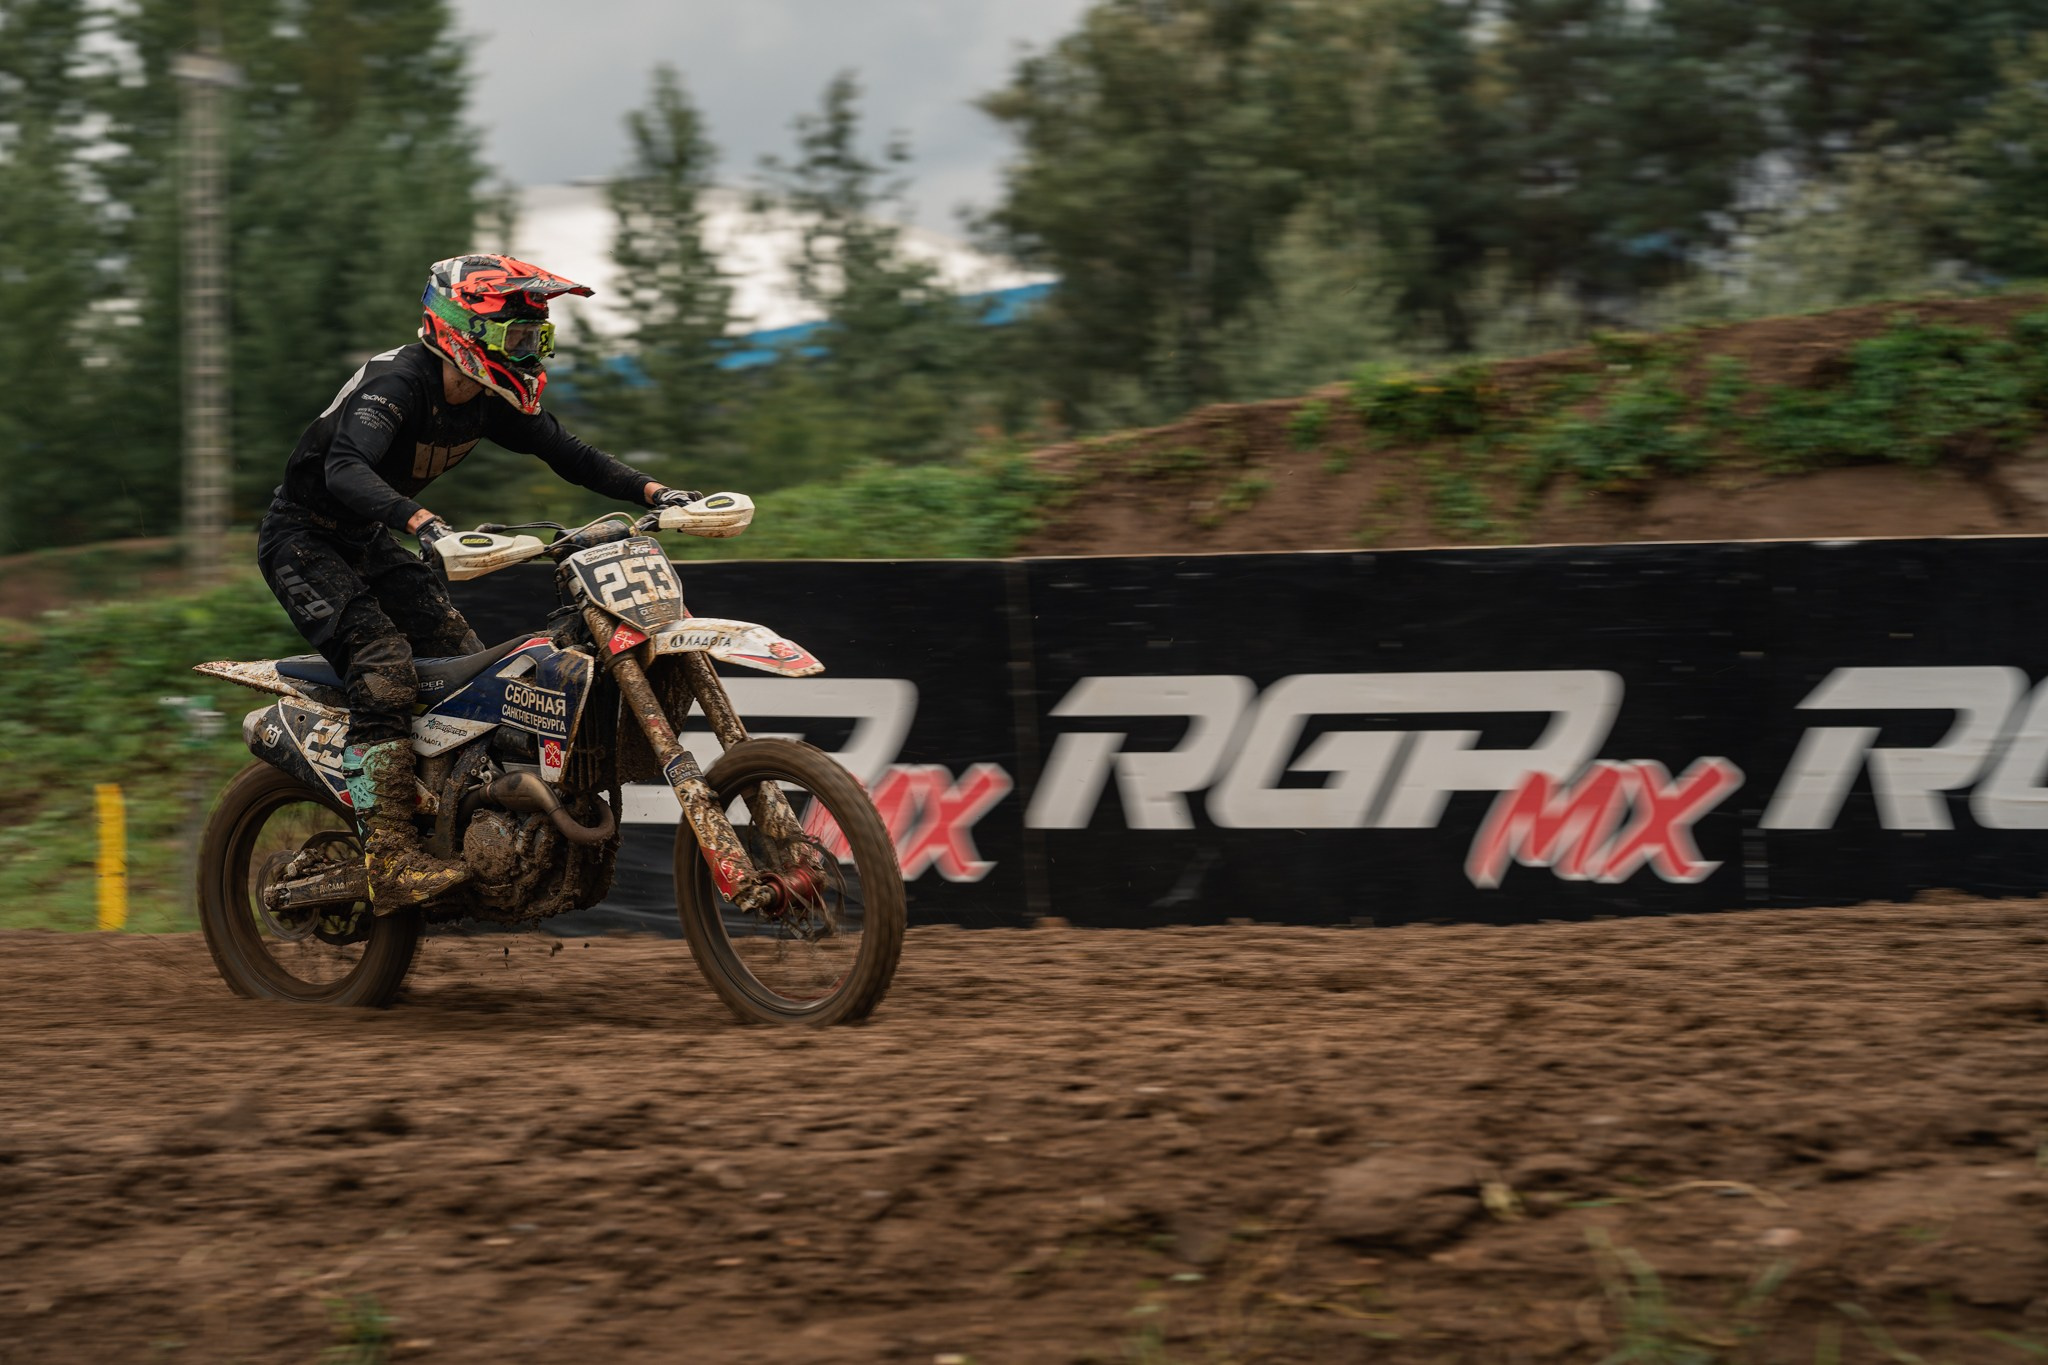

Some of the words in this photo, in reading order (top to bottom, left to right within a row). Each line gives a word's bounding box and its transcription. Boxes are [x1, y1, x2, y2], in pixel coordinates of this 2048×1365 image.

[275, 564, 335, 620] UFO
[593, 555, 680, 612] 253
[504, 683, 567, 717] СБОРНАЯ
[1024, 672, 1623, 830] RGP
[1464, 756, 1745, 890] MX
